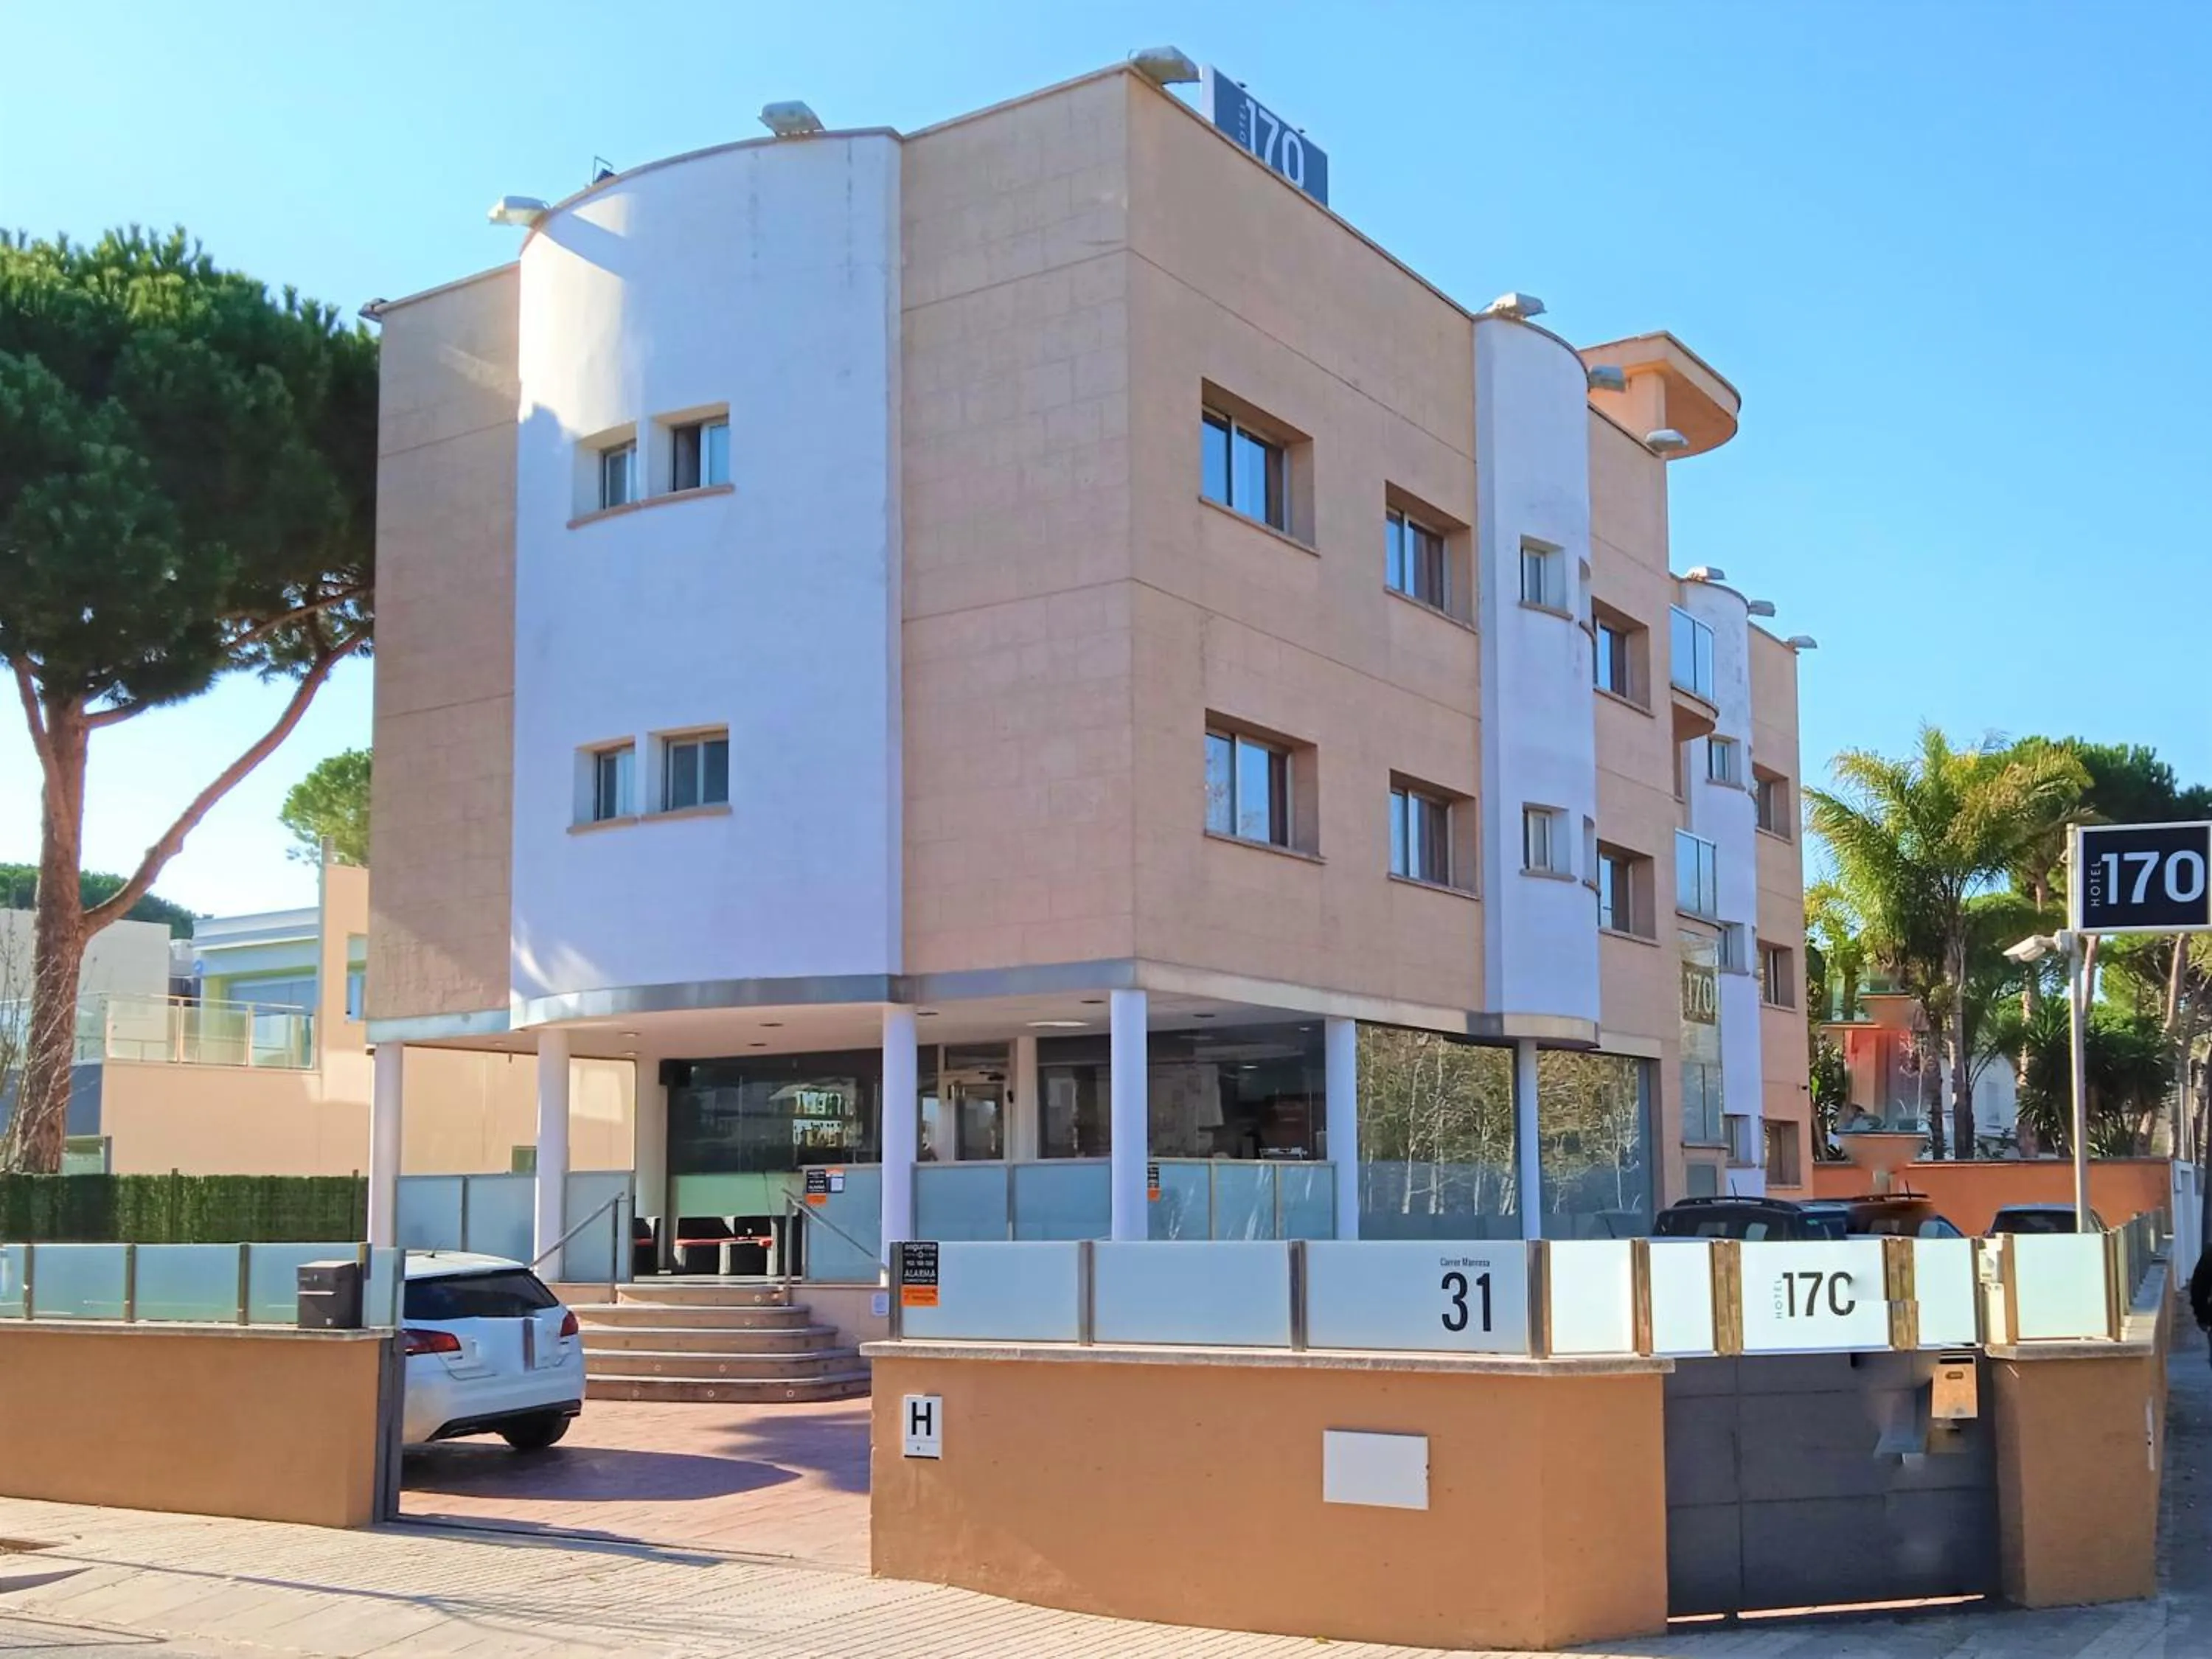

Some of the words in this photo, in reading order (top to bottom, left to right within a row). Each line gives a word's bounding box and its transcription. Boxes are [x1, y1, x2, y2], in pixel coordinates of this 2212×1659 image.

[1246, 98, 1304, 189] 170
[2090, 861, 2101, 907] HOTEL
[2101, 850, 2205, 905] 170
[1686, 973, 1714, 1014] 170
[1441, 1271, 1492, 1332] 31
[911, 1402, 931, 1436] H
